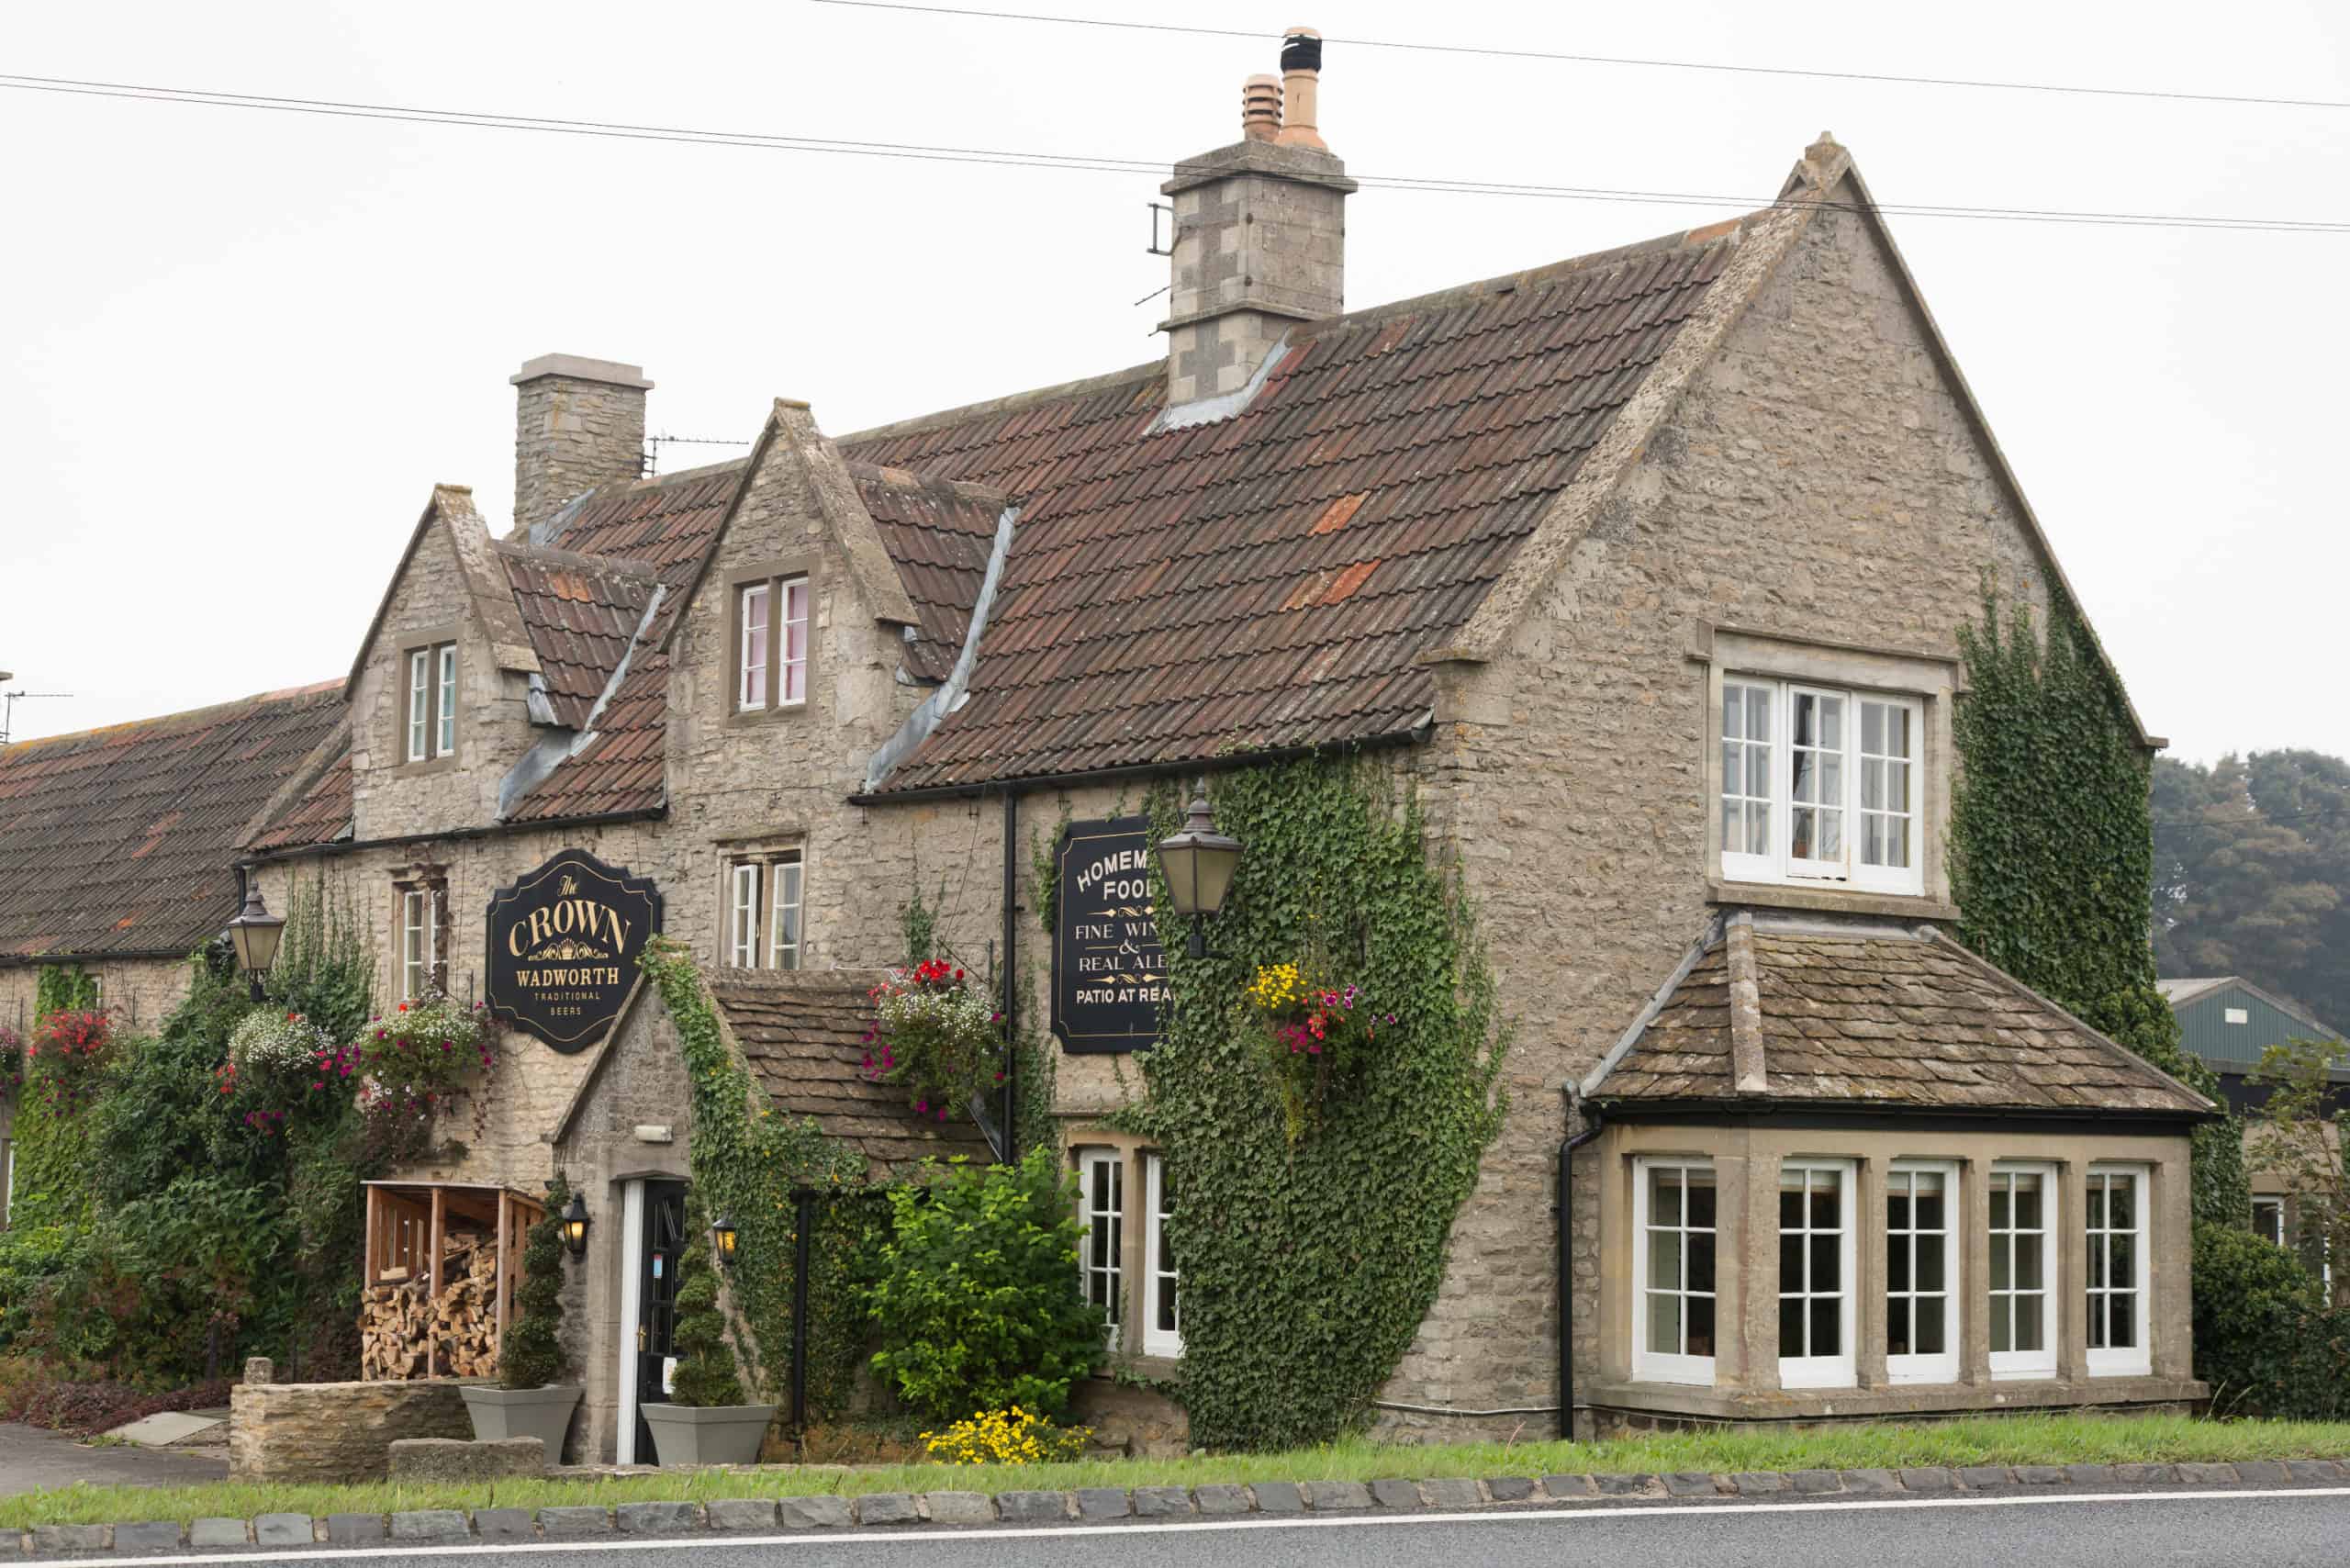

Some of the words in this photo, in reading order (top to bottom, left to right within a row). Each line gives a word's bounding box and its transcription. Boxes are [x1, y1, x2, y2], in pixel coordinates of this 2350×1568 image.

[558, 875, 578, 896] The
[509, 900, 632, 957] CROWN
[1075, 924, 1113, 940] FINE
[1119, 938, 1139, 955] &
[1079, 956, 1125, 971] REAL
[517, 967, 620, 988] WADWORTH
[534, 991, 601, 1002] TRADITIONAL
[1076, 989, 1114, 1004] PATIO
[1118, 988, 1136, 1002] AT
[1139, 987, 1176, 1002] REA
[550, 1006, 581, 1016] BEERS
